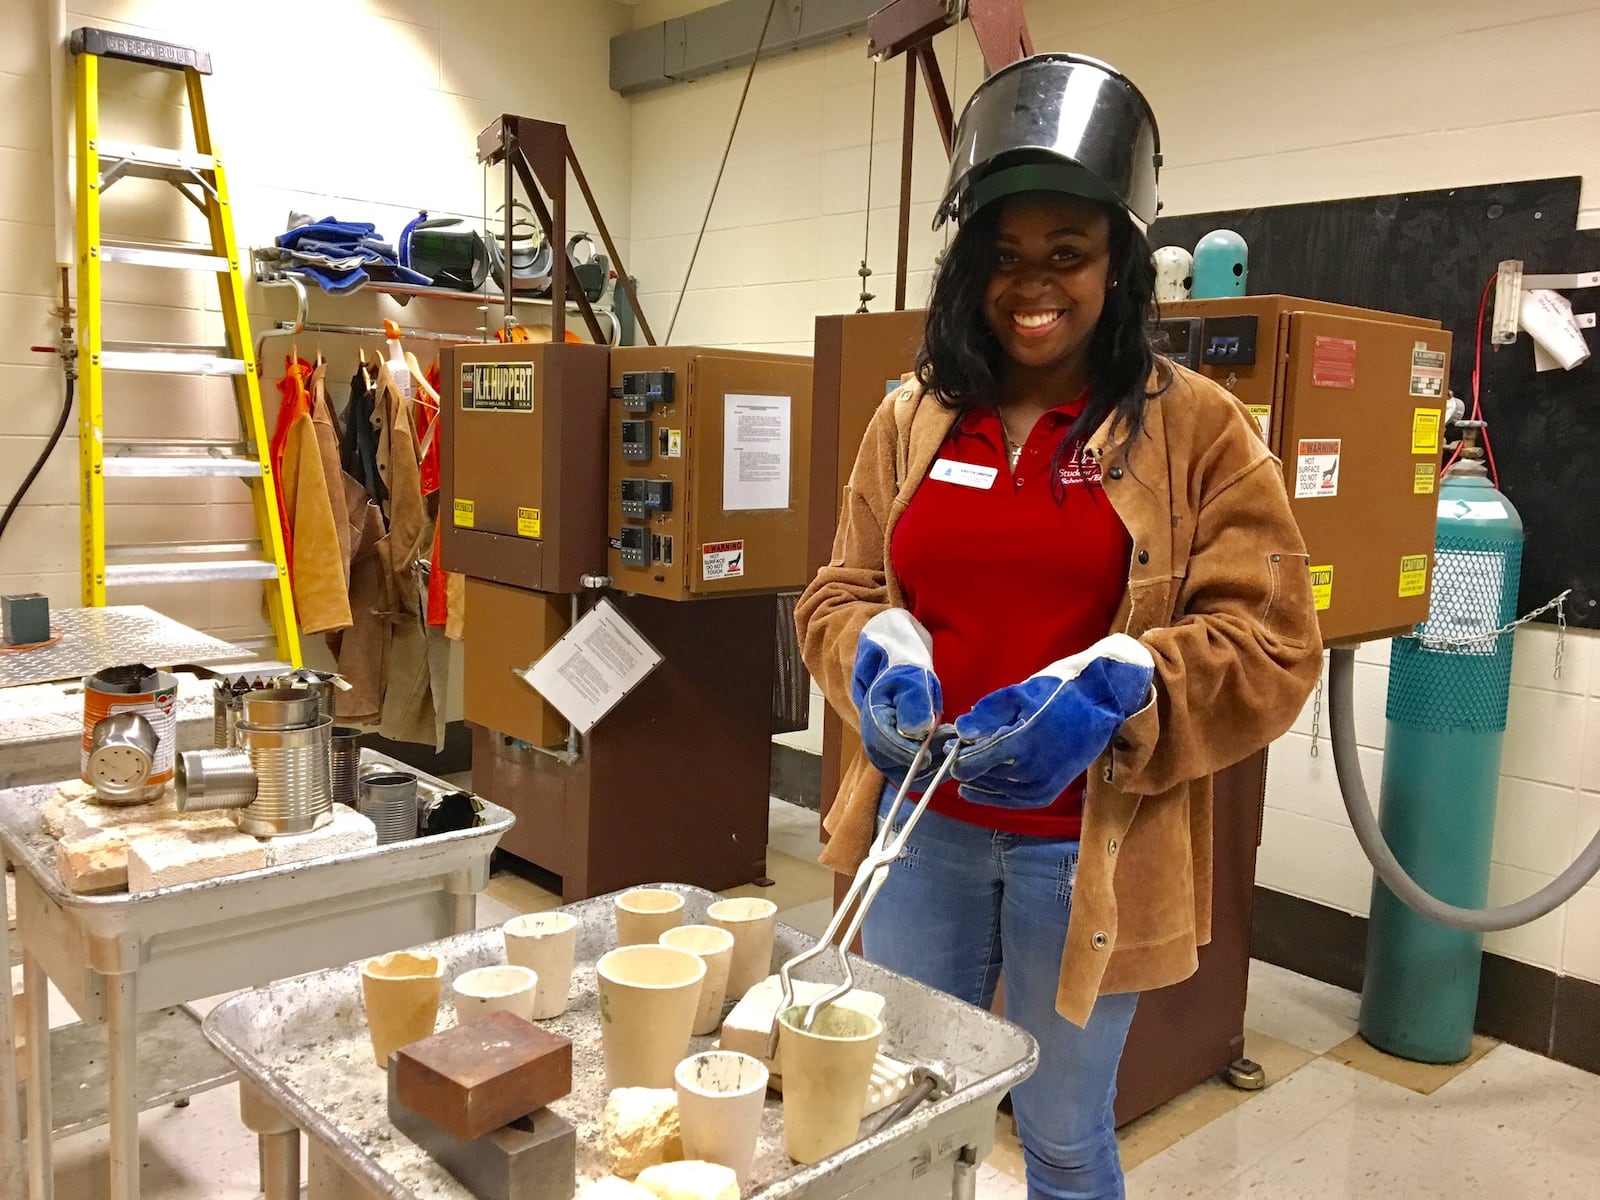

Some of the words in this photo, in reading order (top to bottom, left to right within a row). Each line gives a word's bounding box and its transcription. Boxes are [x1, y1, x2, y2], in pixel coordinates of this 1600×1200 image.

[106, 37, 154, 57] GREEN
[158, 45, 192, 63] BULL
[1307, 442, 1339, 454] WARNING
[1304, 457, 1315, 465] HOT
[1298, 465, 1320, 473] SURFACE
[1308, 473, 1318, 481] NOT
[1300, 482, 1317, 490] TOUCH
[457, 503, 472, 511] CAUTION
[520, 510, 537, 519] CAUTION
[711, 542, 742, 552] WARNING
[1403, 559, 1424, 571] CAUTION
[1311, 572, 1330, 585] UTION
